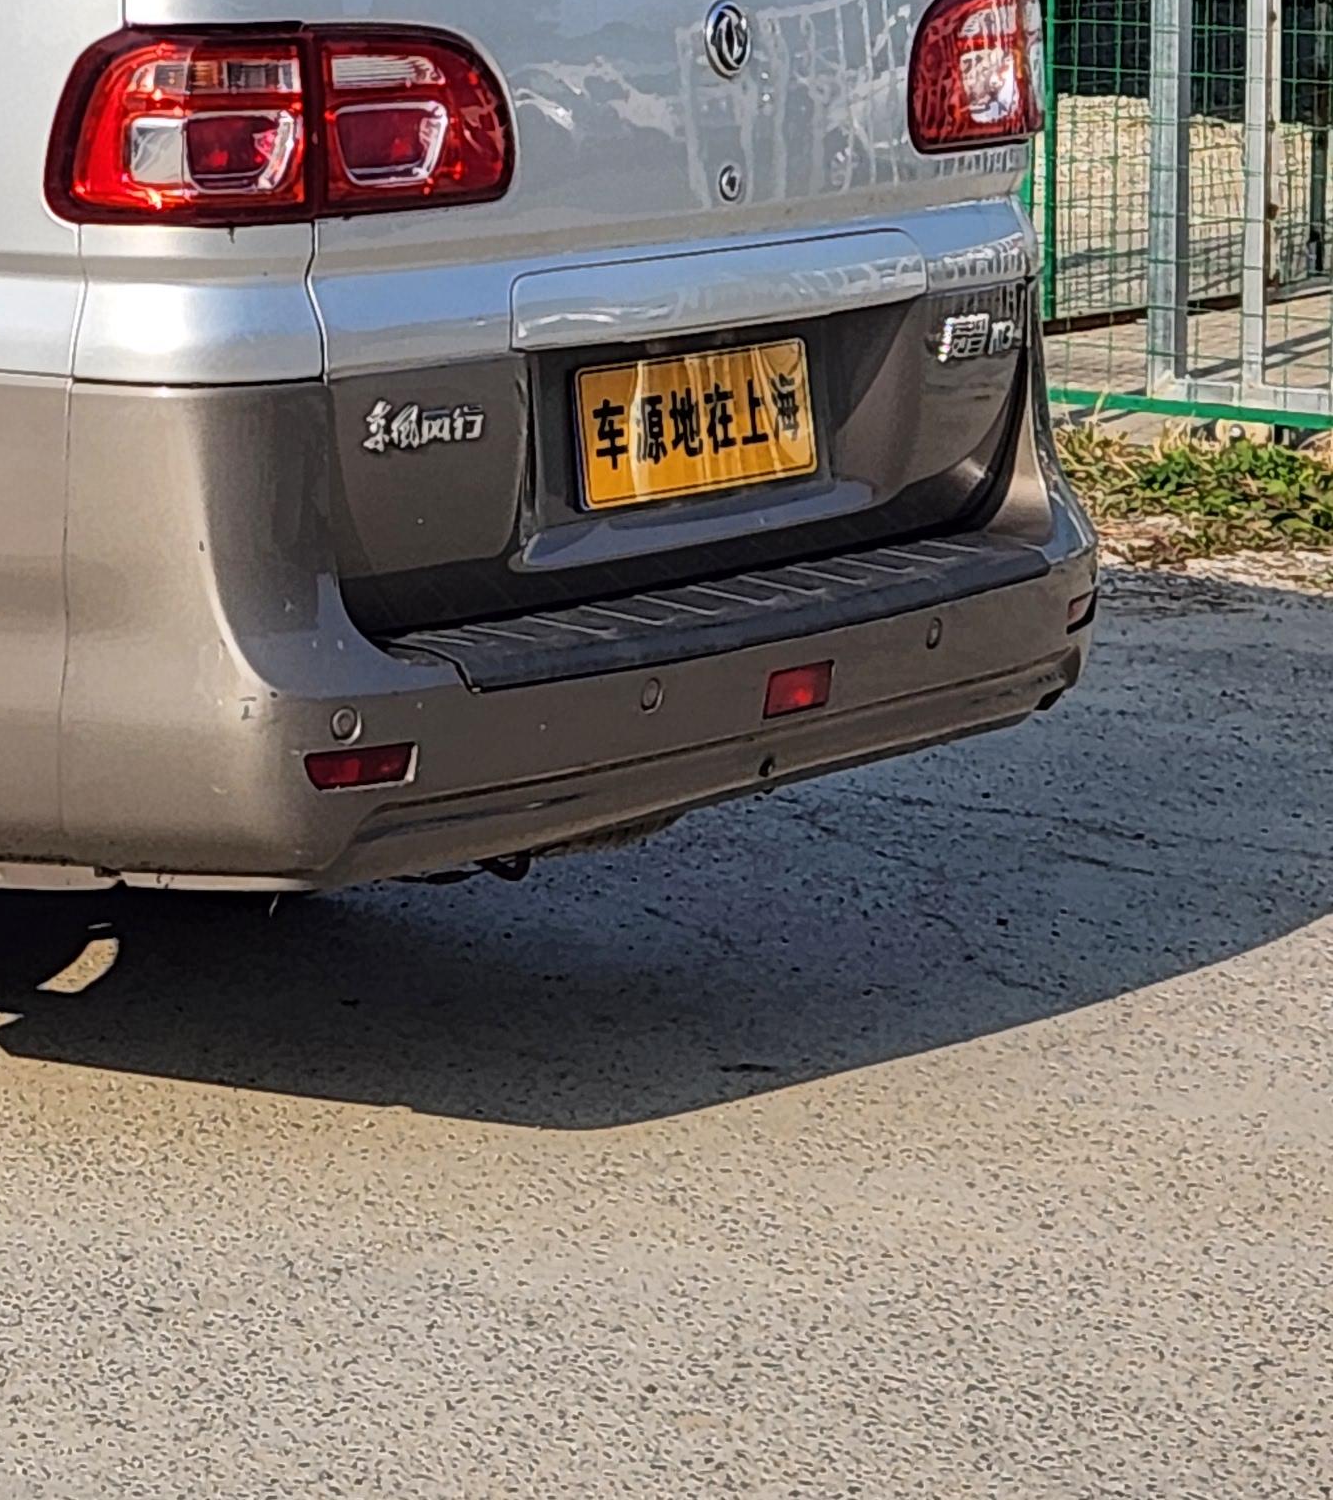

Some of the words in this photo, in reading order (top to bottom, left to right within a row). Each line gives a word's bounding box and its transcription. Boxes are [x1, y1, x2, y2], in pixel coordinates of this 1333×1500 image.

[592, 372, 800, 470] 车源地在上海
